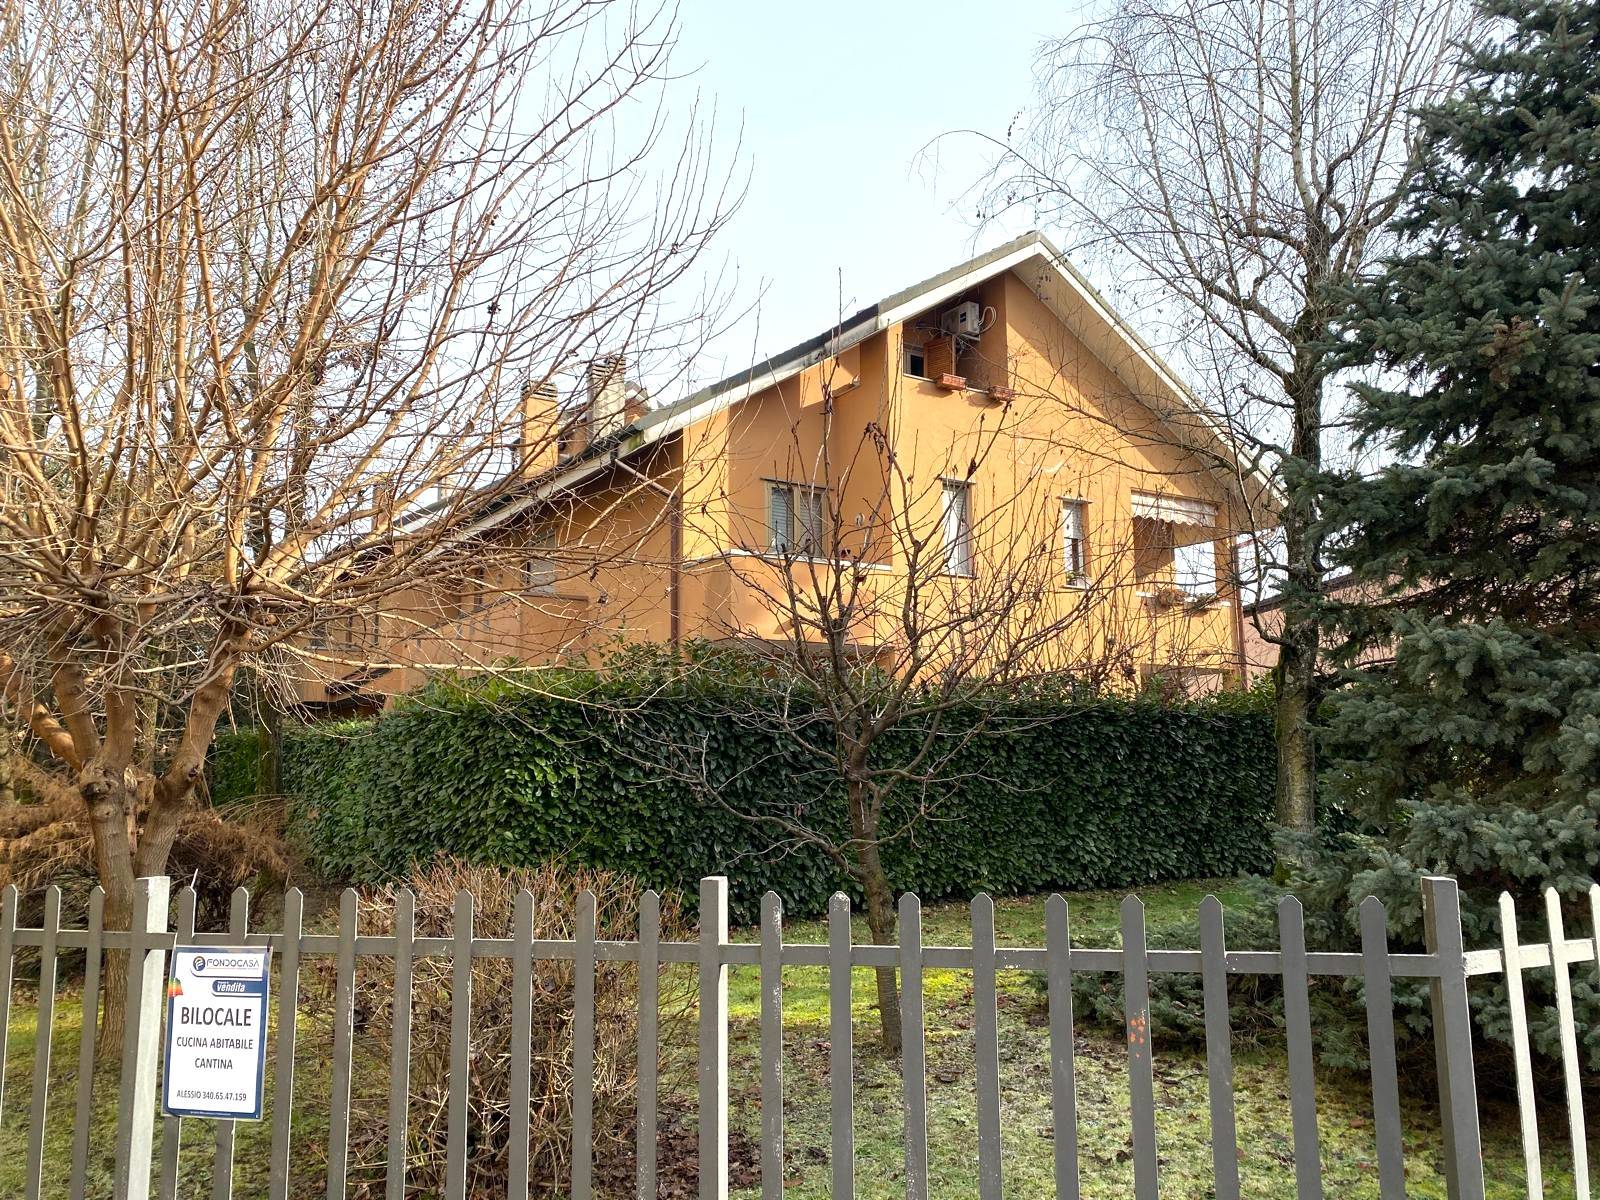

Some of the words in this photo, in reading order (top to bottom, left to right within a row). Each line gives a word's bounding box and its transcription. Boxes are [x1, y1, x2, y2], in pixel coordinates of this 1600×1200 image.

[206, 958, 259, 967] FONDOCASA
[181, 1007, 252, 1026] BILOCALE
[177, 1037, 208, 1048] CUCINA
[210, 1038, 253, 1049] ABITABILE
[195, 1058, 233, 1069] CANTINA
[177, 1090, 201, 1099] ALESSIO
[203, 1092, 247, 1101] 340.65.47.159
